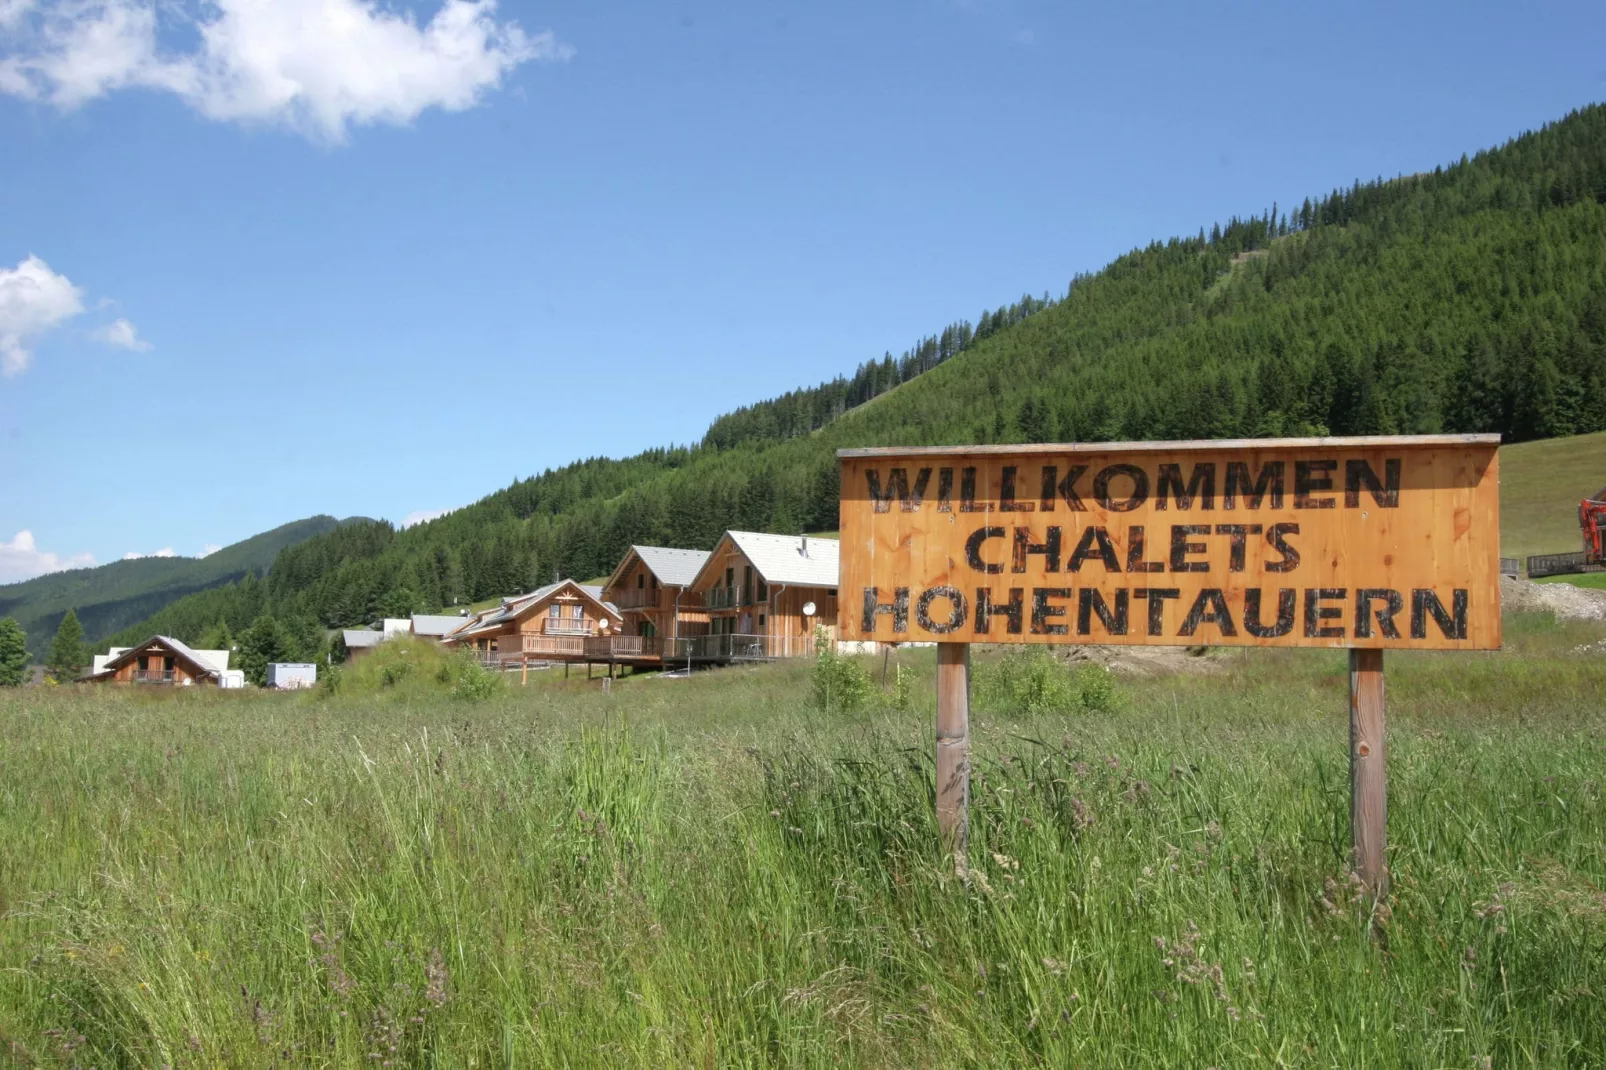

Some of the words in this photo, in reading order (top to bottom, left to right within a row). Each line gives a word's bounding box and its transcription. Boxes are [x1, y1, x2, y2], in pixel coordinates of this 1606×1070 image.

[865, 458, 1401, 513] WILLKOMMEN
[965, 523, 1301, 574] CHALETS
[861, 586, 1468, 640] HOHENTAUERN
